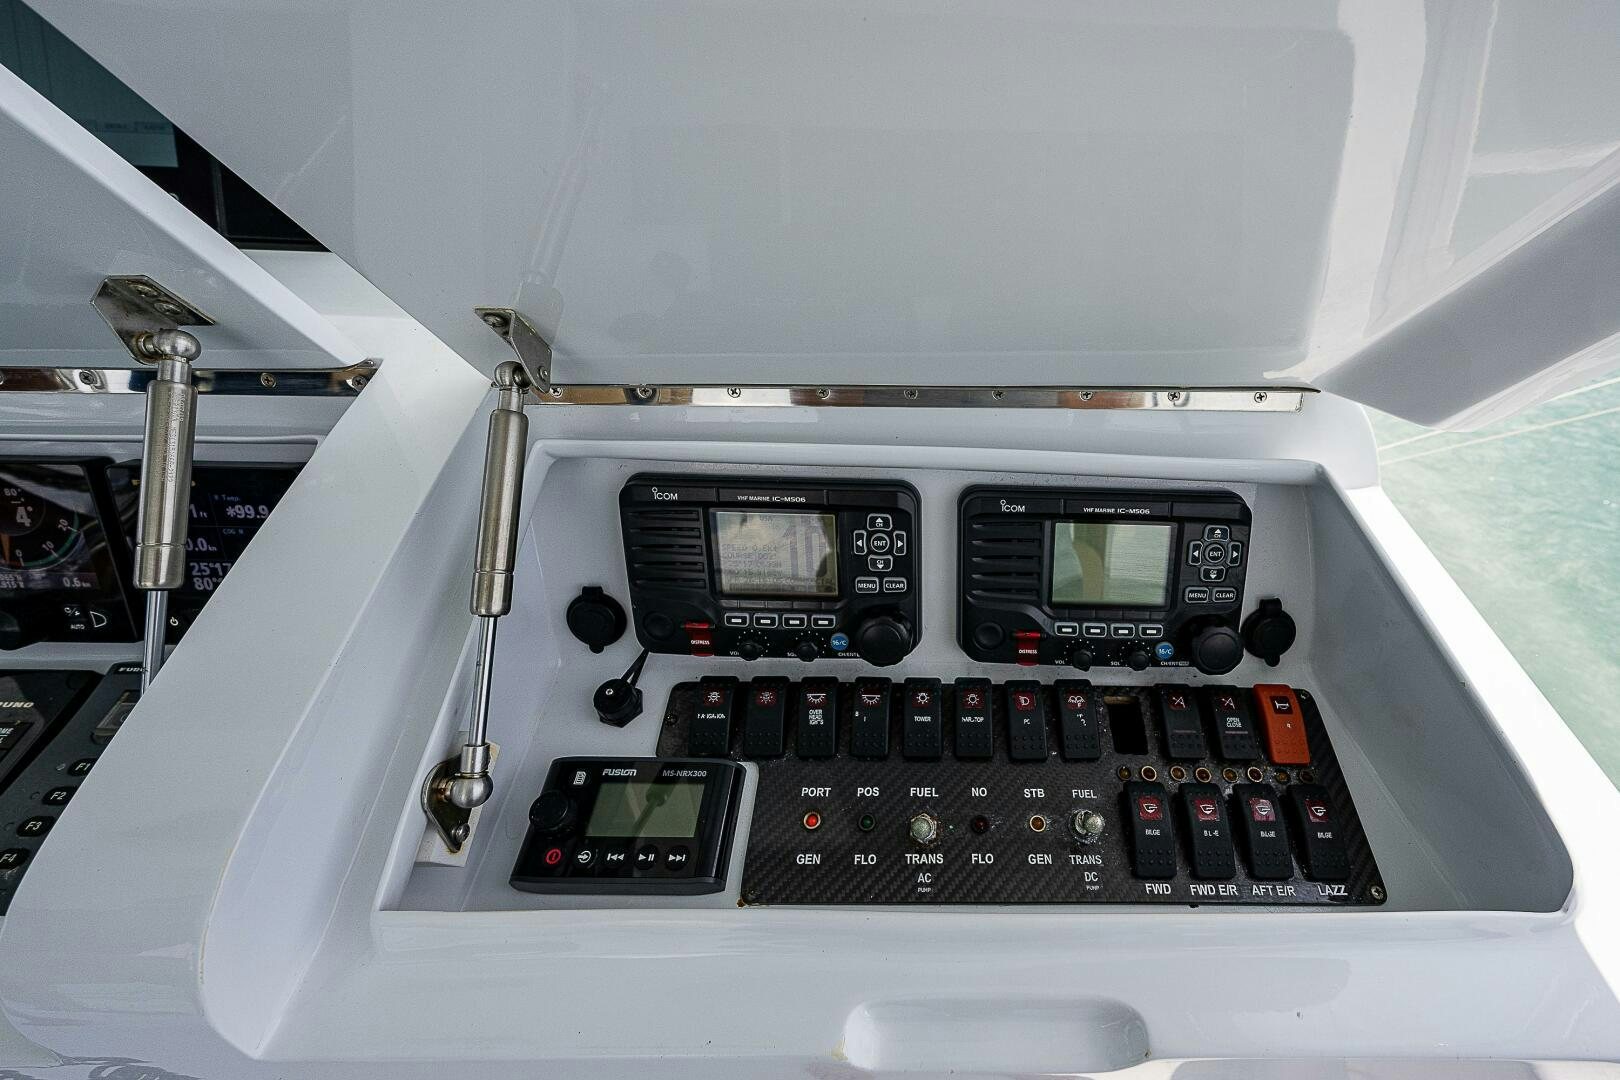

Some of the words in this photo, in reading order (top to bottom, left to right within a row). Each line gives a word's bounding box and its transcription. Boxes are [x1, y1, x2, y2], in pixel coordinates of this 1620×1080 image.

[602, 768, 637, 777] FUSION
[662, 769, 707, 777] MS-NRX300
[50, 791, 67, 800] F2
[801, 787, 832, 797] PORT
[857, 787, 880, 797] POS
[910, 787, 939, 797] FUEL
[971, 787, 988, 797] NO
[1023, 788, 1045, 798] STB
[1072, 789, 1098, 799] FUEL
[25, 821, 43, 830] F3
[796, 854, 821, 865] GEN
[854, 854, 877, 865] FLO
[905, 853, 944, 864] TRANS
[971, 853, 994, 864] FLO
[1028, 854, 1053, 865] GEN
[1069, 855, 1102, 865] TRANS
[917, 873, 932, 883] AC
[1084, 872, 1099, 882] DC
[1145, 884, 1171, 895] FWD
[1190, 884, 1216, 896] FWD
[1219, 885, 1238, 896] E/R
[1252, 885, 1273, 896] AFT
[1277, 885, 1296, 897] E/R
[1317, 885, 1348, 896] LAZZ
